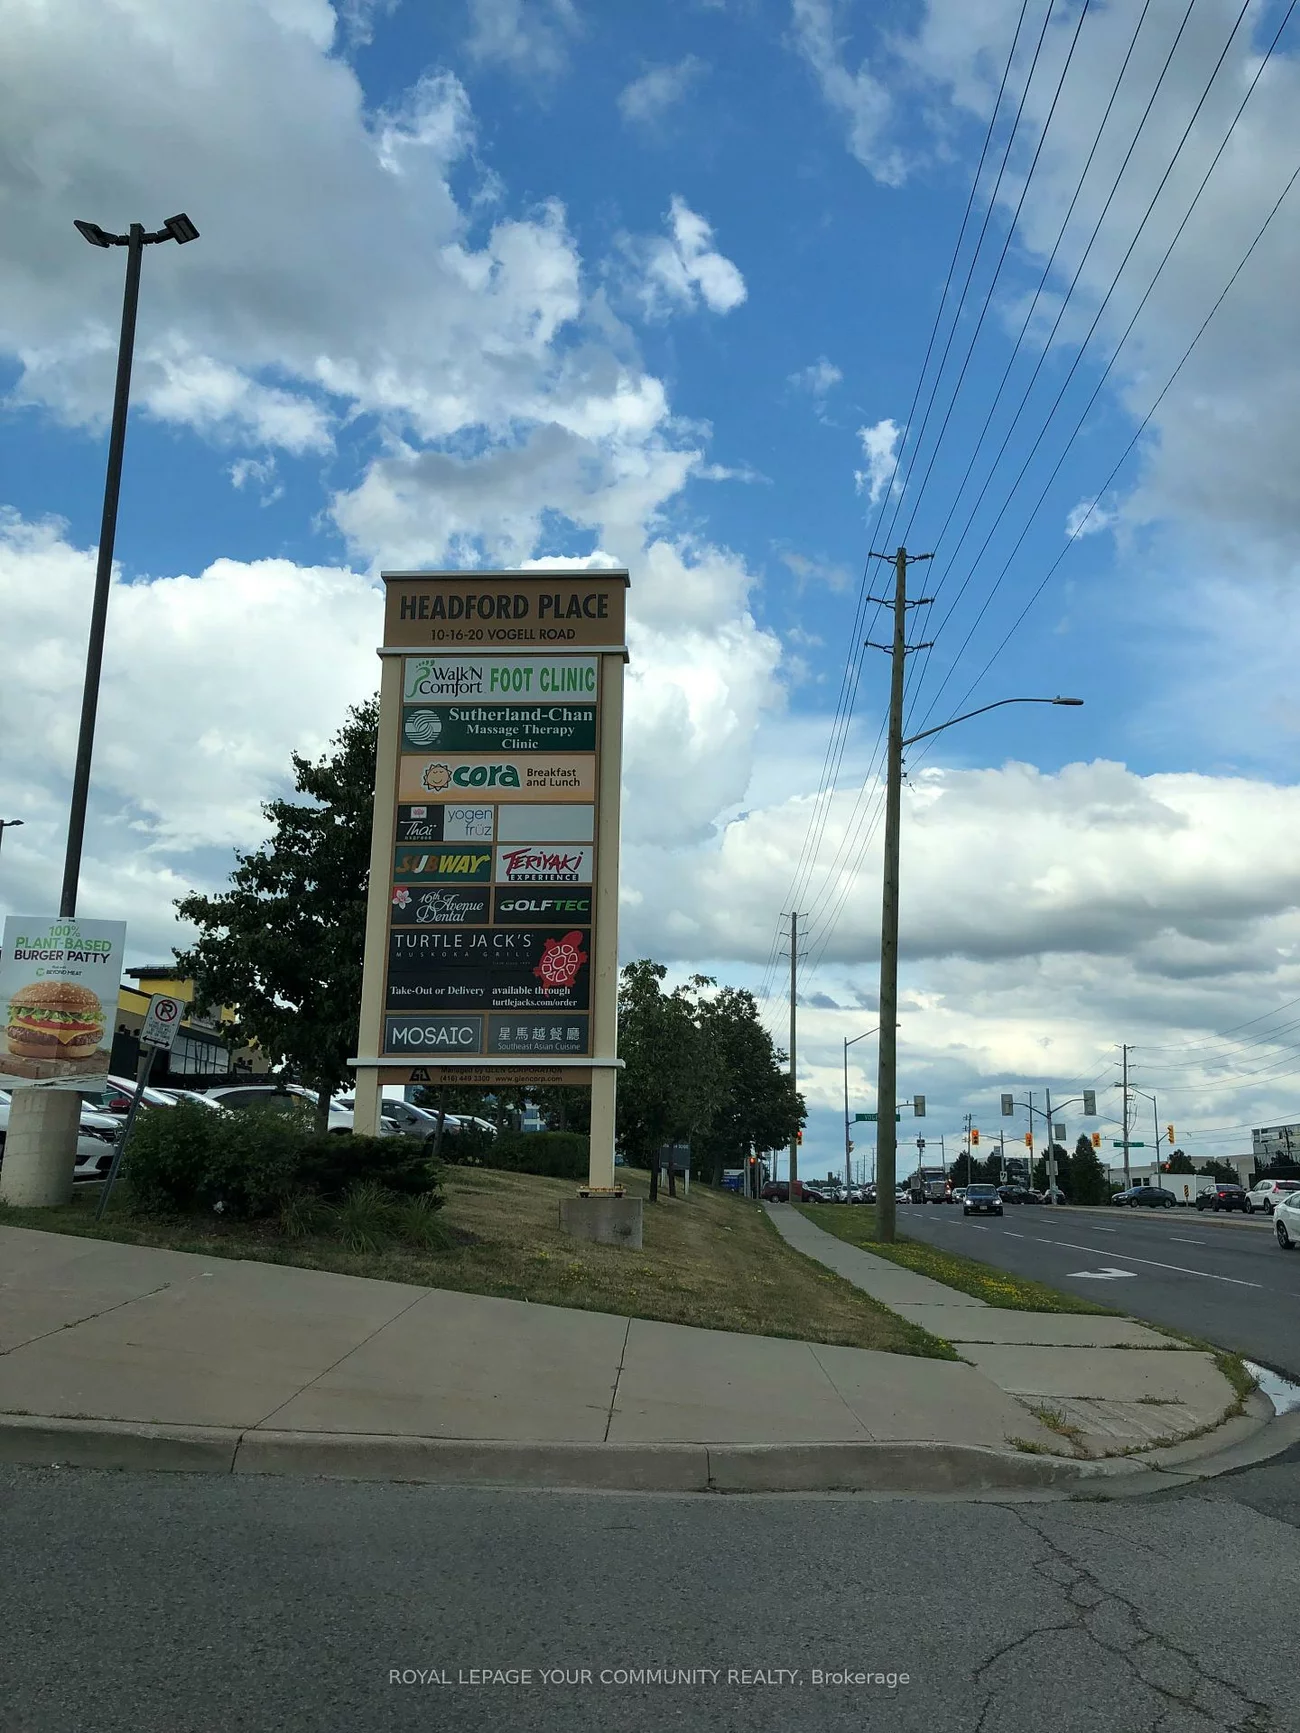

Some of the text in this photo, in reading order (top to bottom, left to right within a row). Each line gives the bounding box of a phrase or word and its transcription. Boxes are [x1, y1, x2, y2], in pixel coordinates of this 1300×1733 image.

[400, 594, 609, 619] HEADFORD PLACE
[431, 629, 575, 641] 10-16-20 VOGELL ROAD
[490, 667, 595, 692] FOOT CLINIC
[419, 678, 483, 697] Comfort
[449, 707, 593, 721] Sutherland-Chan
[466, 724, 575, 736] Massage Therapy
[502, 739, 539, 749] Clinic
[453, 764, 521, 788] cora
[527, 768, 577, 777] Breakfast
[526, 778, 580, 787] and Lunch
[448, 809, 493, 823] yogen
[396, 854, 491, 873] SUBWAY
[418, 889, 484, 911] 16th Avenue
[500, 900, 590, 911] GOLFTEC
[416, 904, 466, 923] Dental
[49, 925, 80, 937] 100%
[15, 937, 112, 952] PLANT-BASED
[395, 934, 532, 948] TURTLE JACK'S
[14, 950, 110, 963] BURGER PATTY
[390, 986, 433, 995] Take-Out
[448, 986, 485, 997] Delivery
[492, 986, 532, 995] available
[534, 986, 570, 996] through
[492, 999, 577, 1007] turtlejacks.com/order
[392, 1027, 474, 1045] MOSAIC
[498, 1027, 580, 1041] 星馬越餐廳
[498, 1042, 581, 1050] Southeast Asian Cuisine
